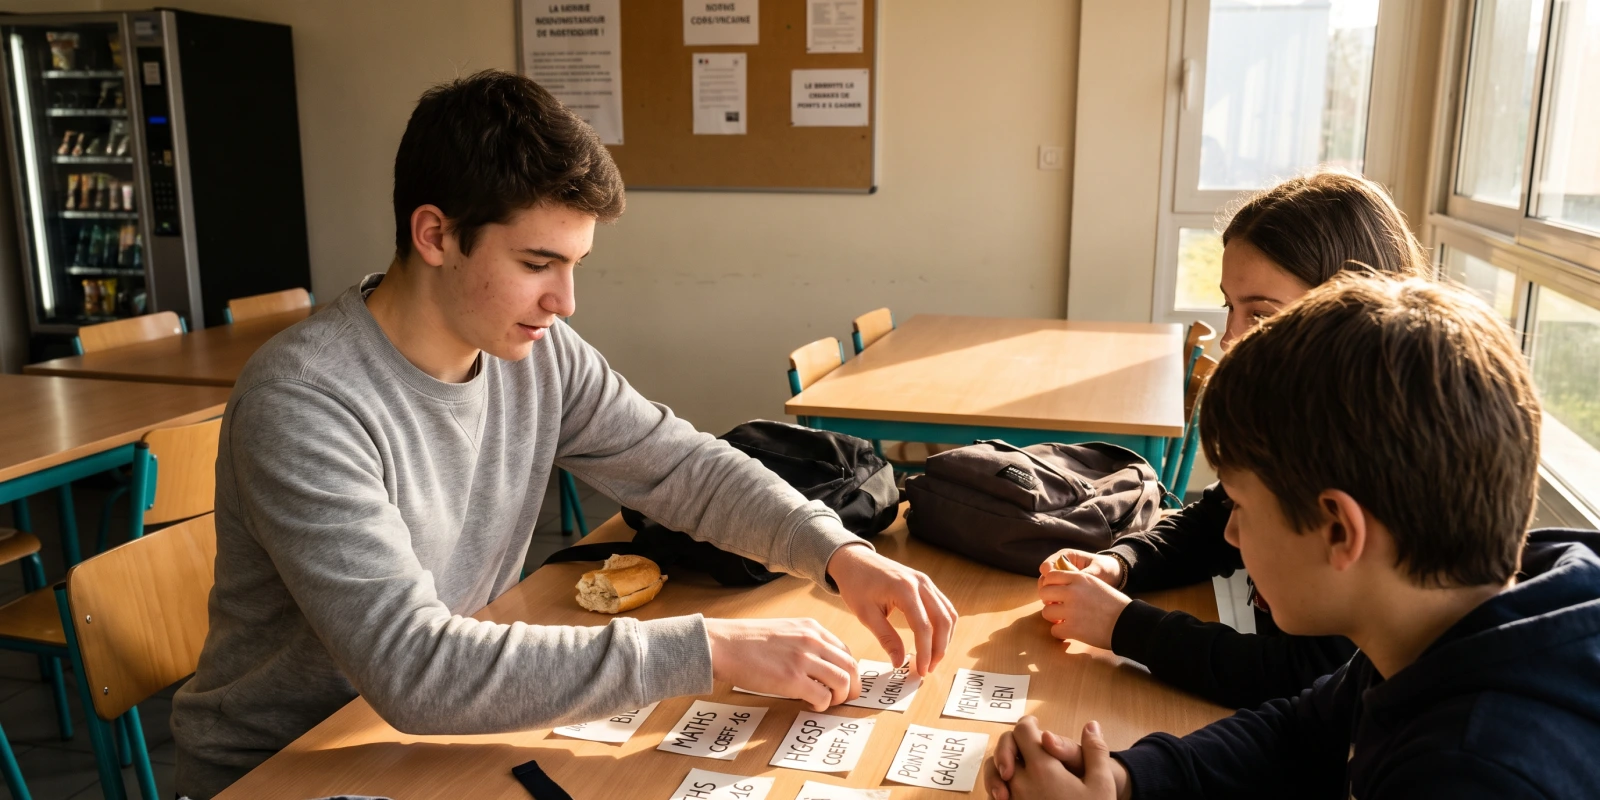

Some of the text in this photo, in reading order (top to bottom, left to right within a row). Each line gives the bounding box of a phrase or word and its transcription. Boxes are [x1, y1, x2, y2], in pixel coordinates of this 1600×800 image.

[956, 673, 985, 715] MENTION
[989, 685, 1015, 710] BIEN
[672, 711, 718, 749] MATHS
[709, 712, 751, 753] COEFF 16
[784, 719, 826, 762] HGGSP
[822, 722, 859, 766] COEFF 16
[897, 742, 928, 779] POINTS
[930, 737, 968, 786] GAGNER
[729, 783, 754, 799] 16
